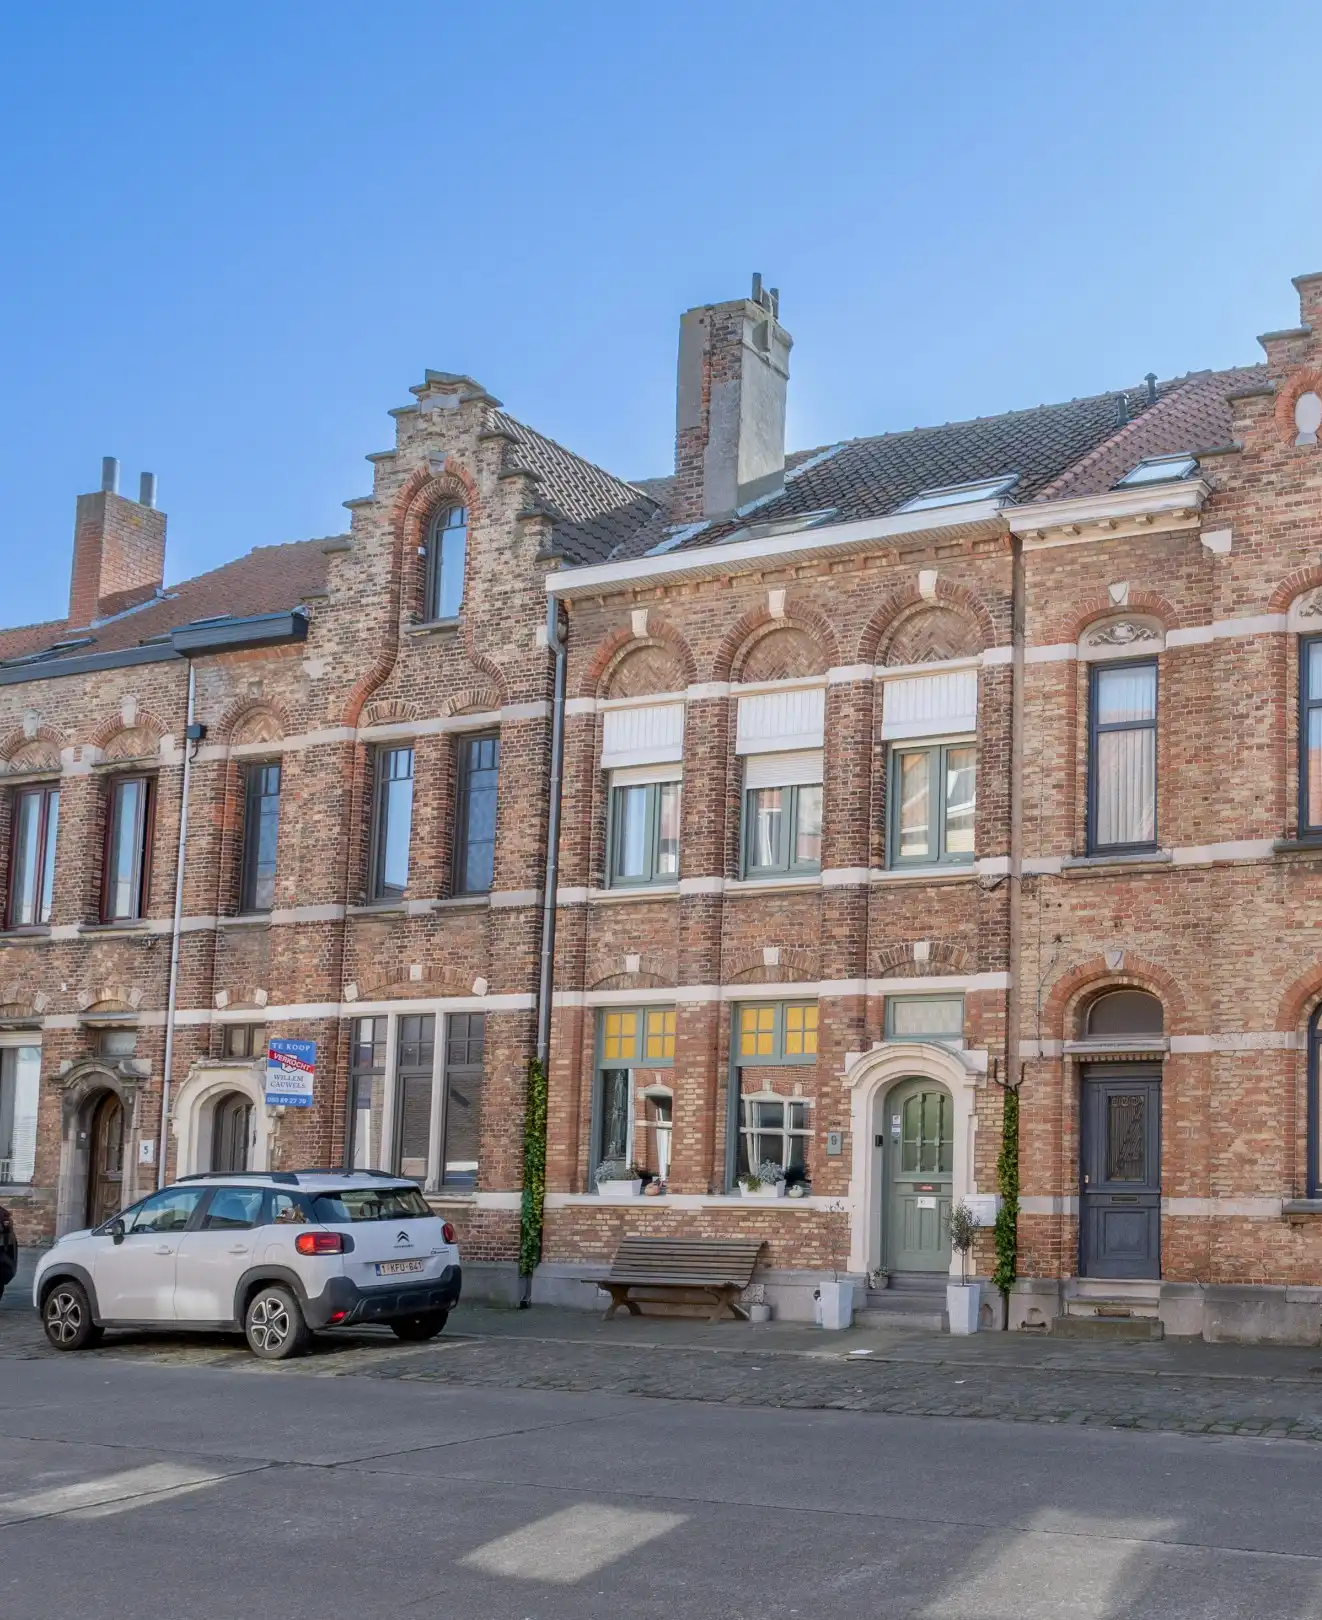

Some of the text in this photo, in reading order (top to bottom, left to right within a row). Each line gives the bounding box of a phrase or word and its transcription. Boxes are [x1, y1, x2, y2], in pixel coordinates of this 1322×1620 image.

[286, 1043, 311, 1051] KOOP
[274, 1052, 312, 1071] VERKOCHT
[273, 1074, 304, 1082] WILLEM
[270, 1081, 306, 1089] CAUWELS
[143, 1145, 149, 1155] 5
